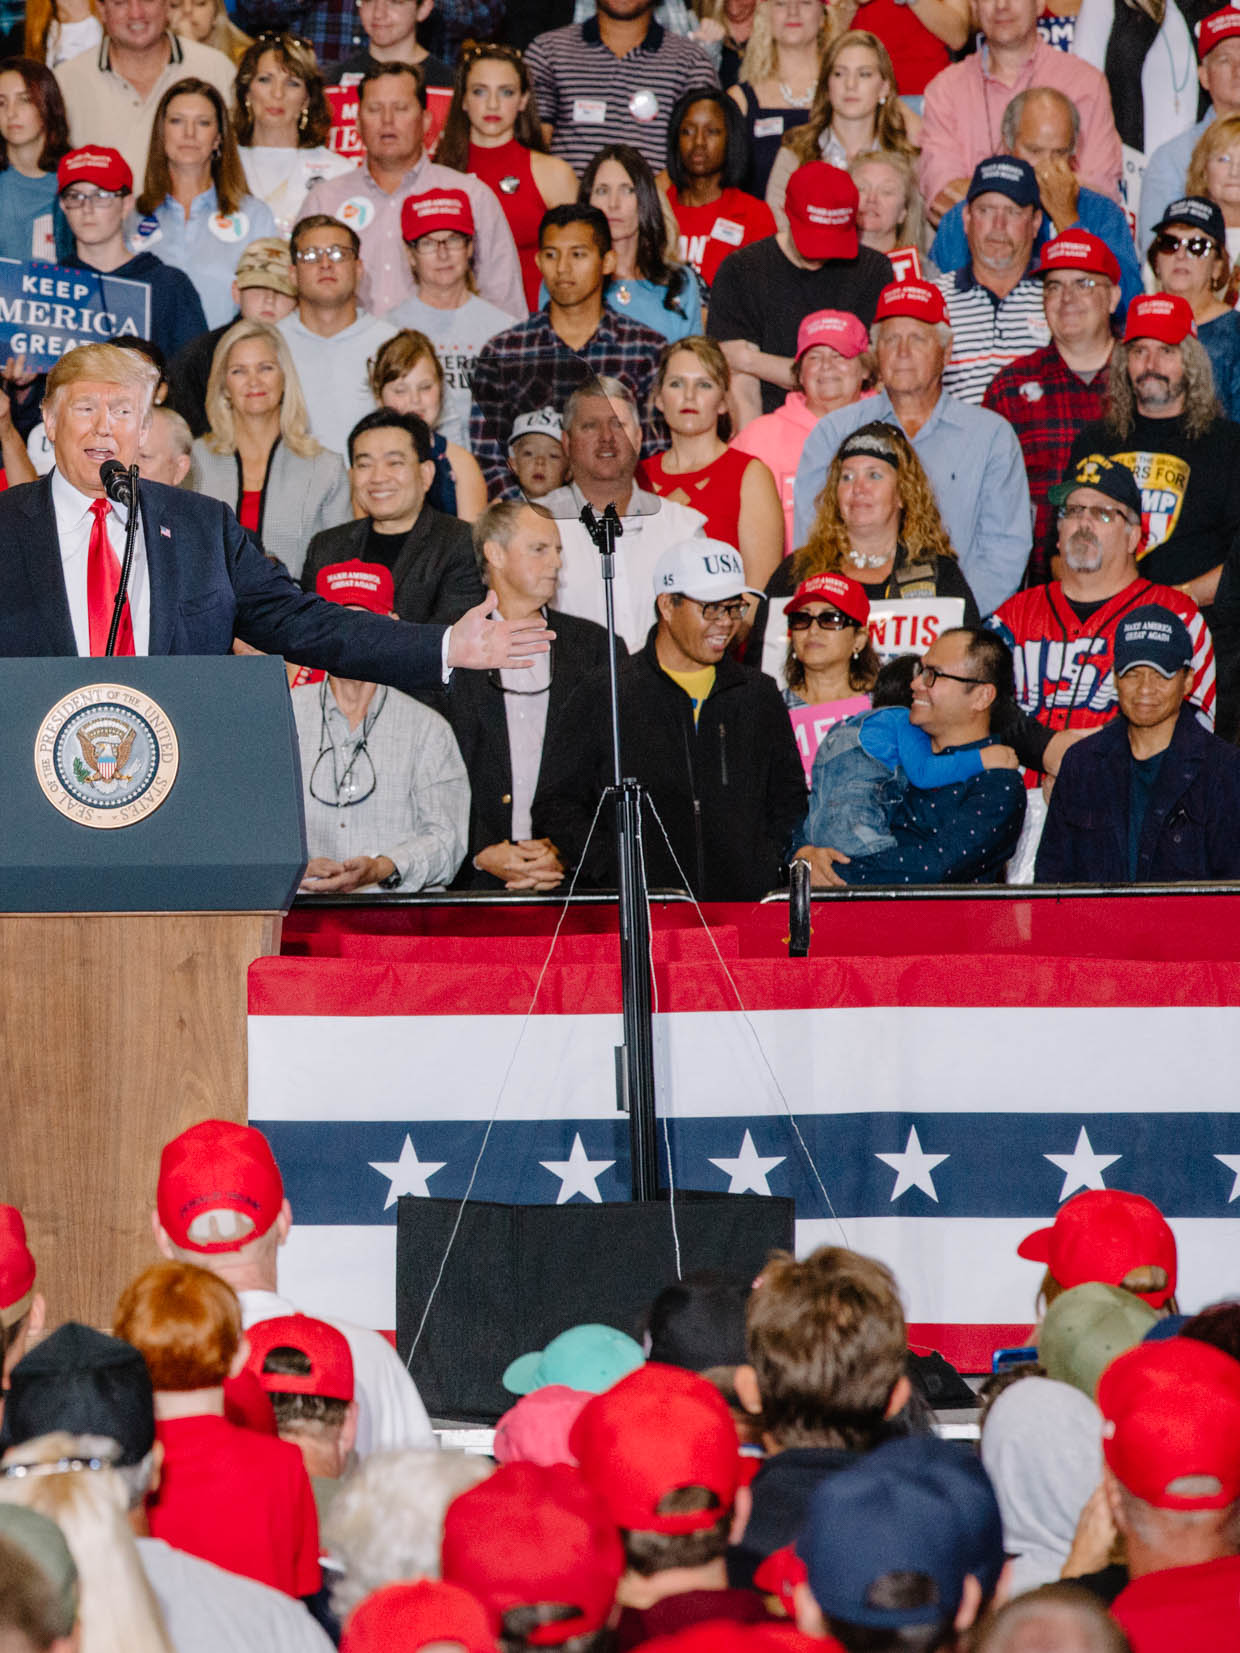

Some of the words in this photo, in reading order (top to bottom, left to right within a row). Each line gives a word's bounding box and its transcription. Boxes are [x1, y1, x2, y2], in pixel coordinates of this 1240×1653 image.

[22, 275, 90, 301] KEEP
[1155, 467, 1185, 488] FOR
[703, 554, 742, 575] USA
[663, 573, 675, 587] 45
[869, 614, 939, 647] NTIS
[1142, 621, 1172, 634] AMERICA
[108, 691, 120, 700] OF
[123, 693, 140, 706] THE
[40, 689, 104, 752] PRESIDENT
[145, 705, 173, 763] UNITED
[42, 759, 52, 778] THE
[48, 780, 58, 792] OF
[59, 791, 94, 820] SEAL
[121, 777, 166, 820] STATES
